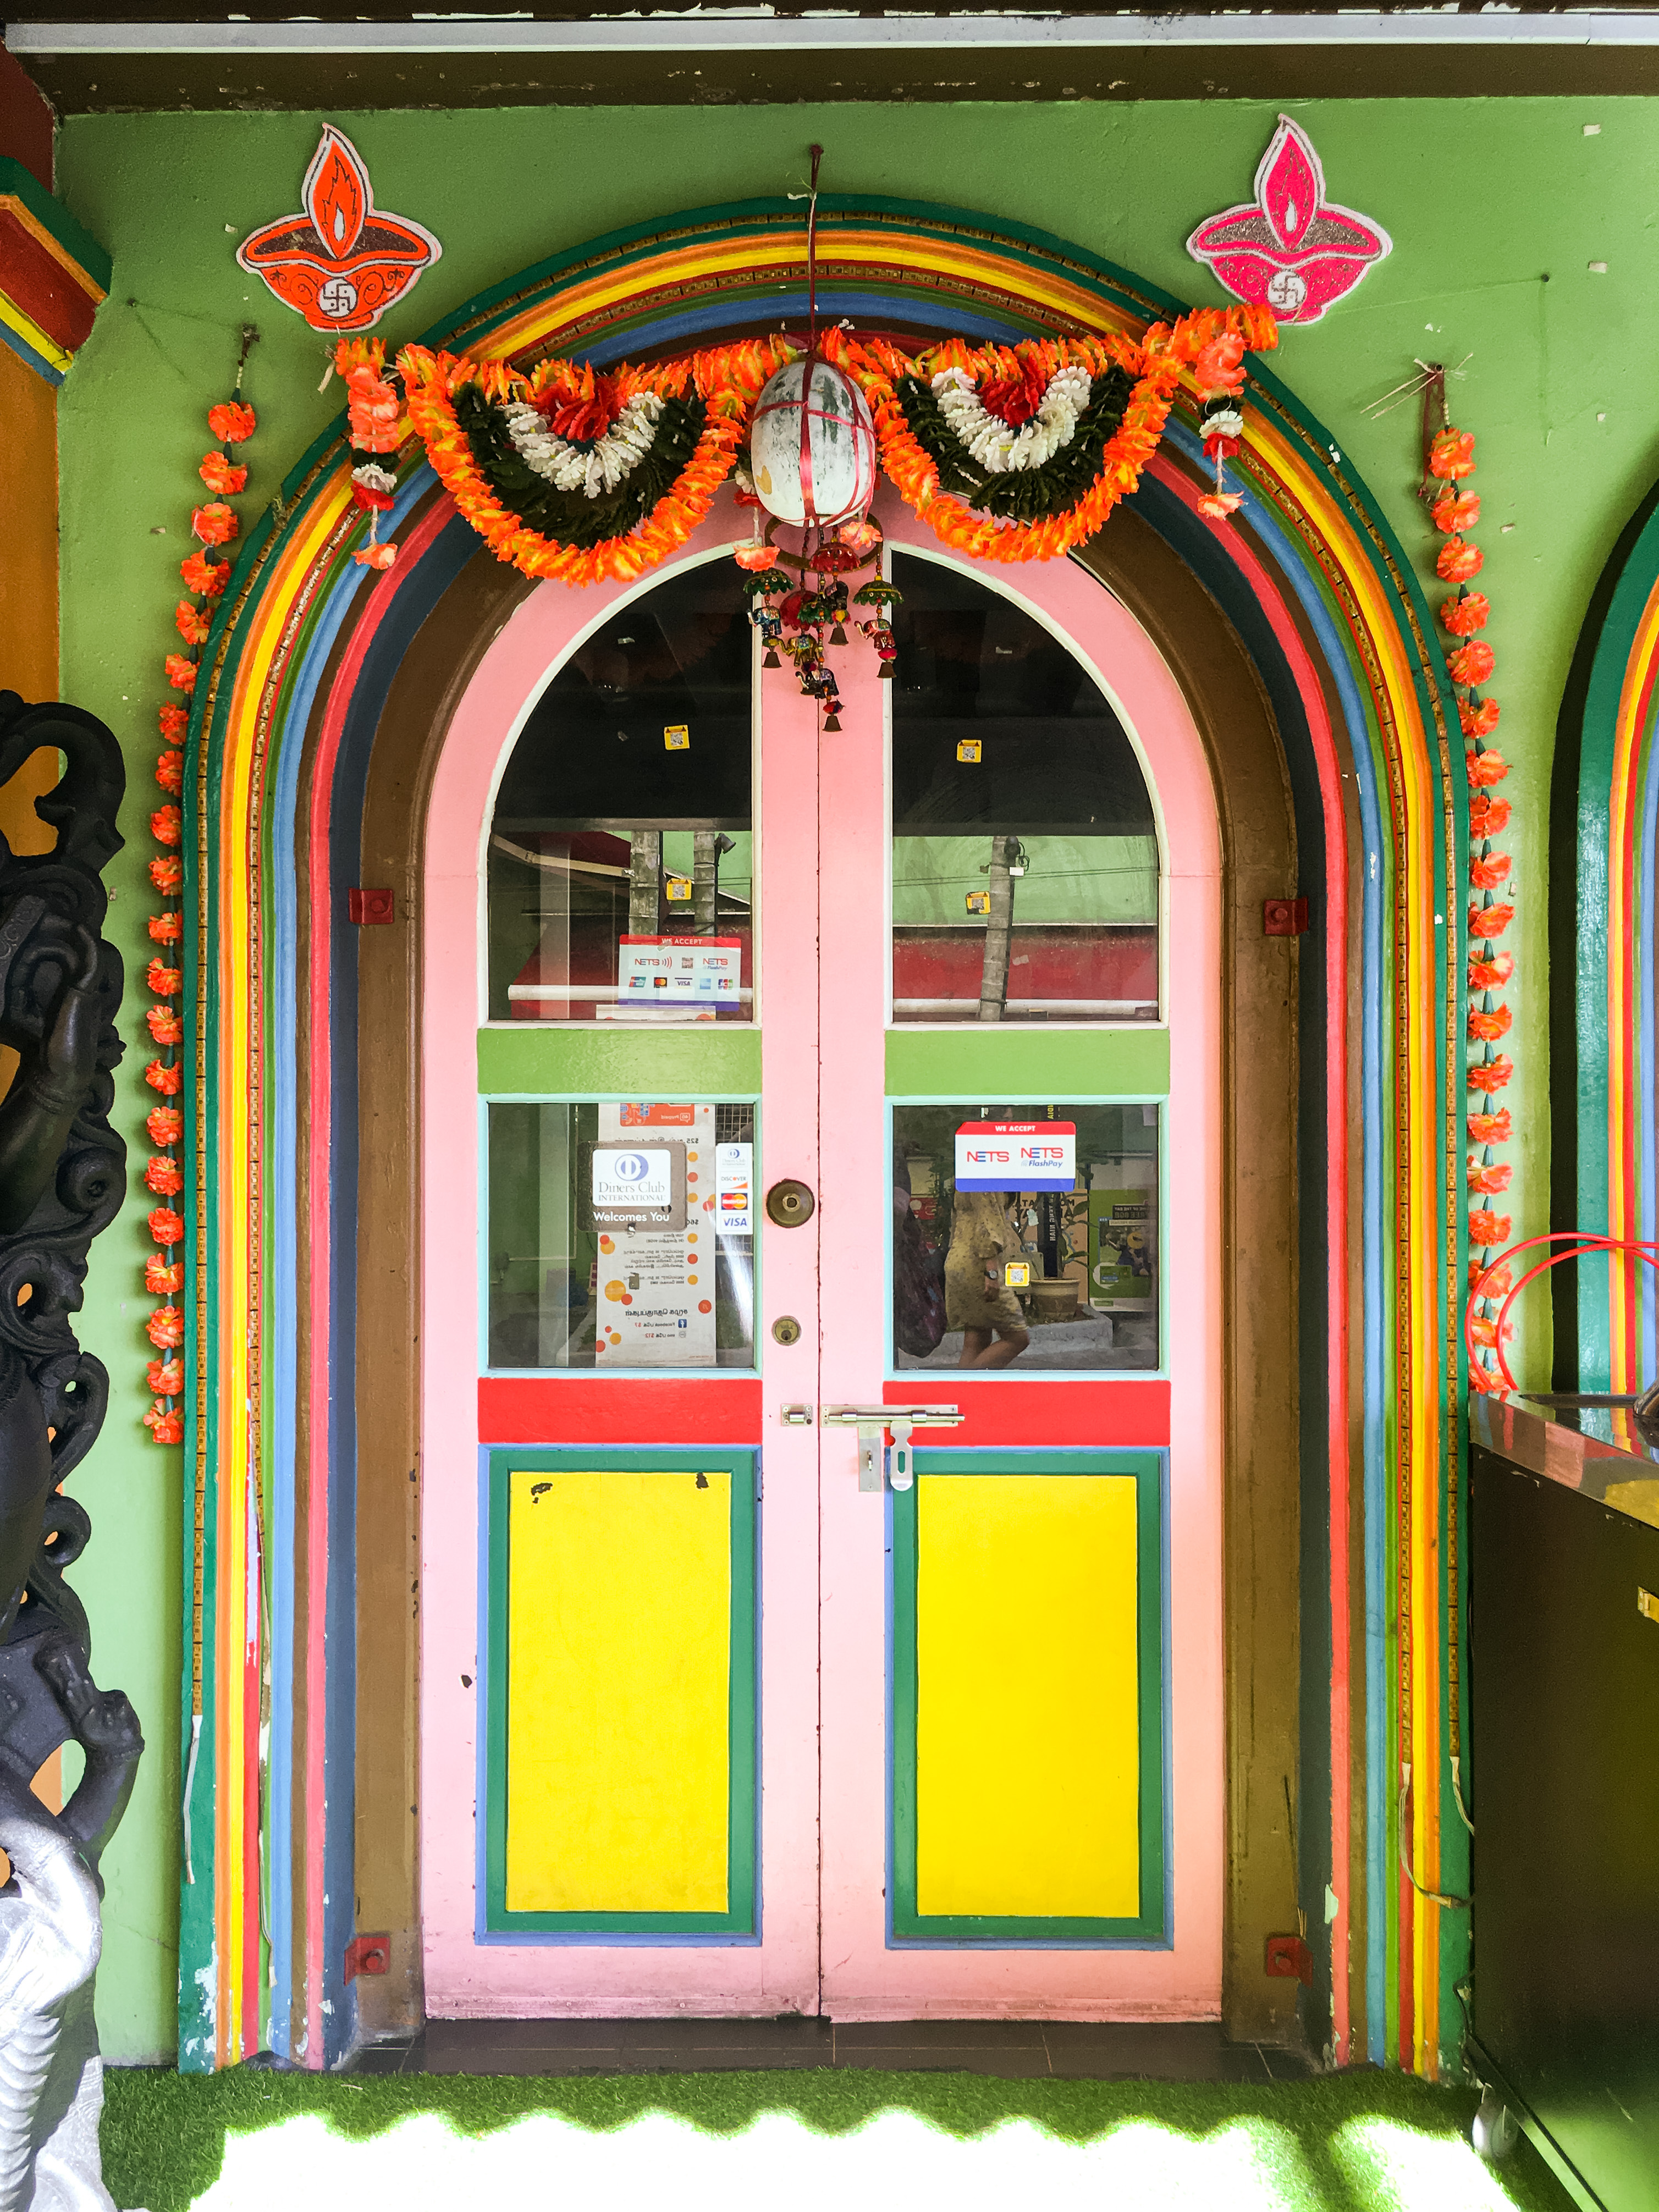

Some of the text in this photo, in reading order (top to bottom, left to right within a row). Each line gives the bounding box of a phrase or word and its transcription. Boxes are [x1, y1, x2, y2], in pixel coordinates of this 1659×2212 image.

[967, 1151, 1010, 1162] NETS
[1021, 1148, 1063, 1159] NETS
[1029, 1160, 1063, 1168] FlashPay
[598, 1182, 665, 1193] Diners Club
[593, 1211, 670, 1222] Welcomes You
[724, 1218, 747, 1226] VISA
